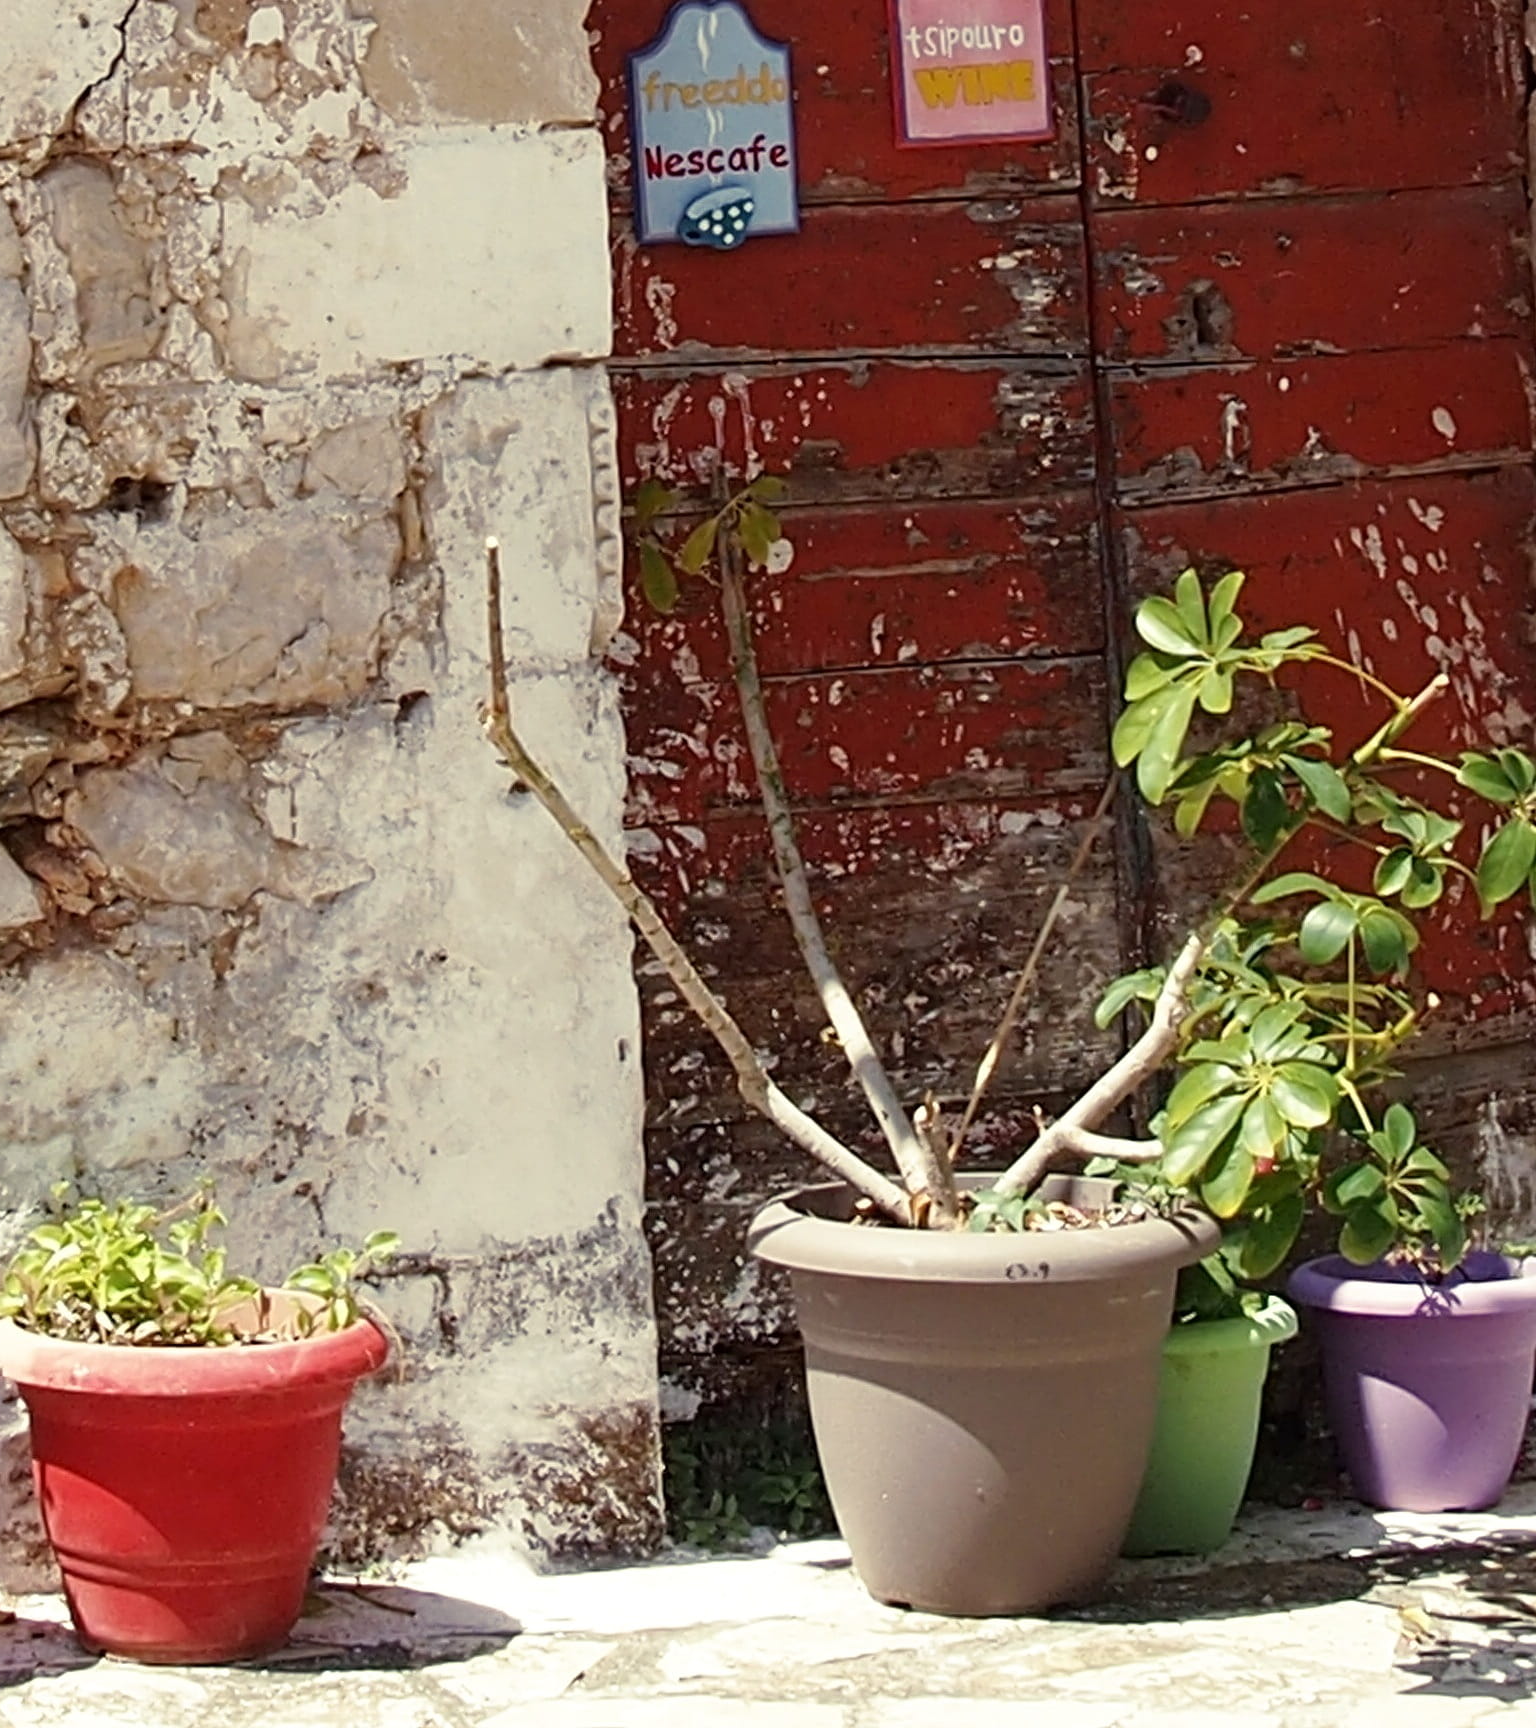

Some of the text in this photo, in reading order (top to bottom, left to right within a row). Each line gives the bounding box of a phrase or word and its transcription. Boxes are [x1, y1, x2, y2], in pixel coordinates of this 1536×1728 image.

[905, 20, 1024, 58] tsipouro
[914, 60, 1036, 109] WINE
[644, 134, 789, 180] Nescafe
